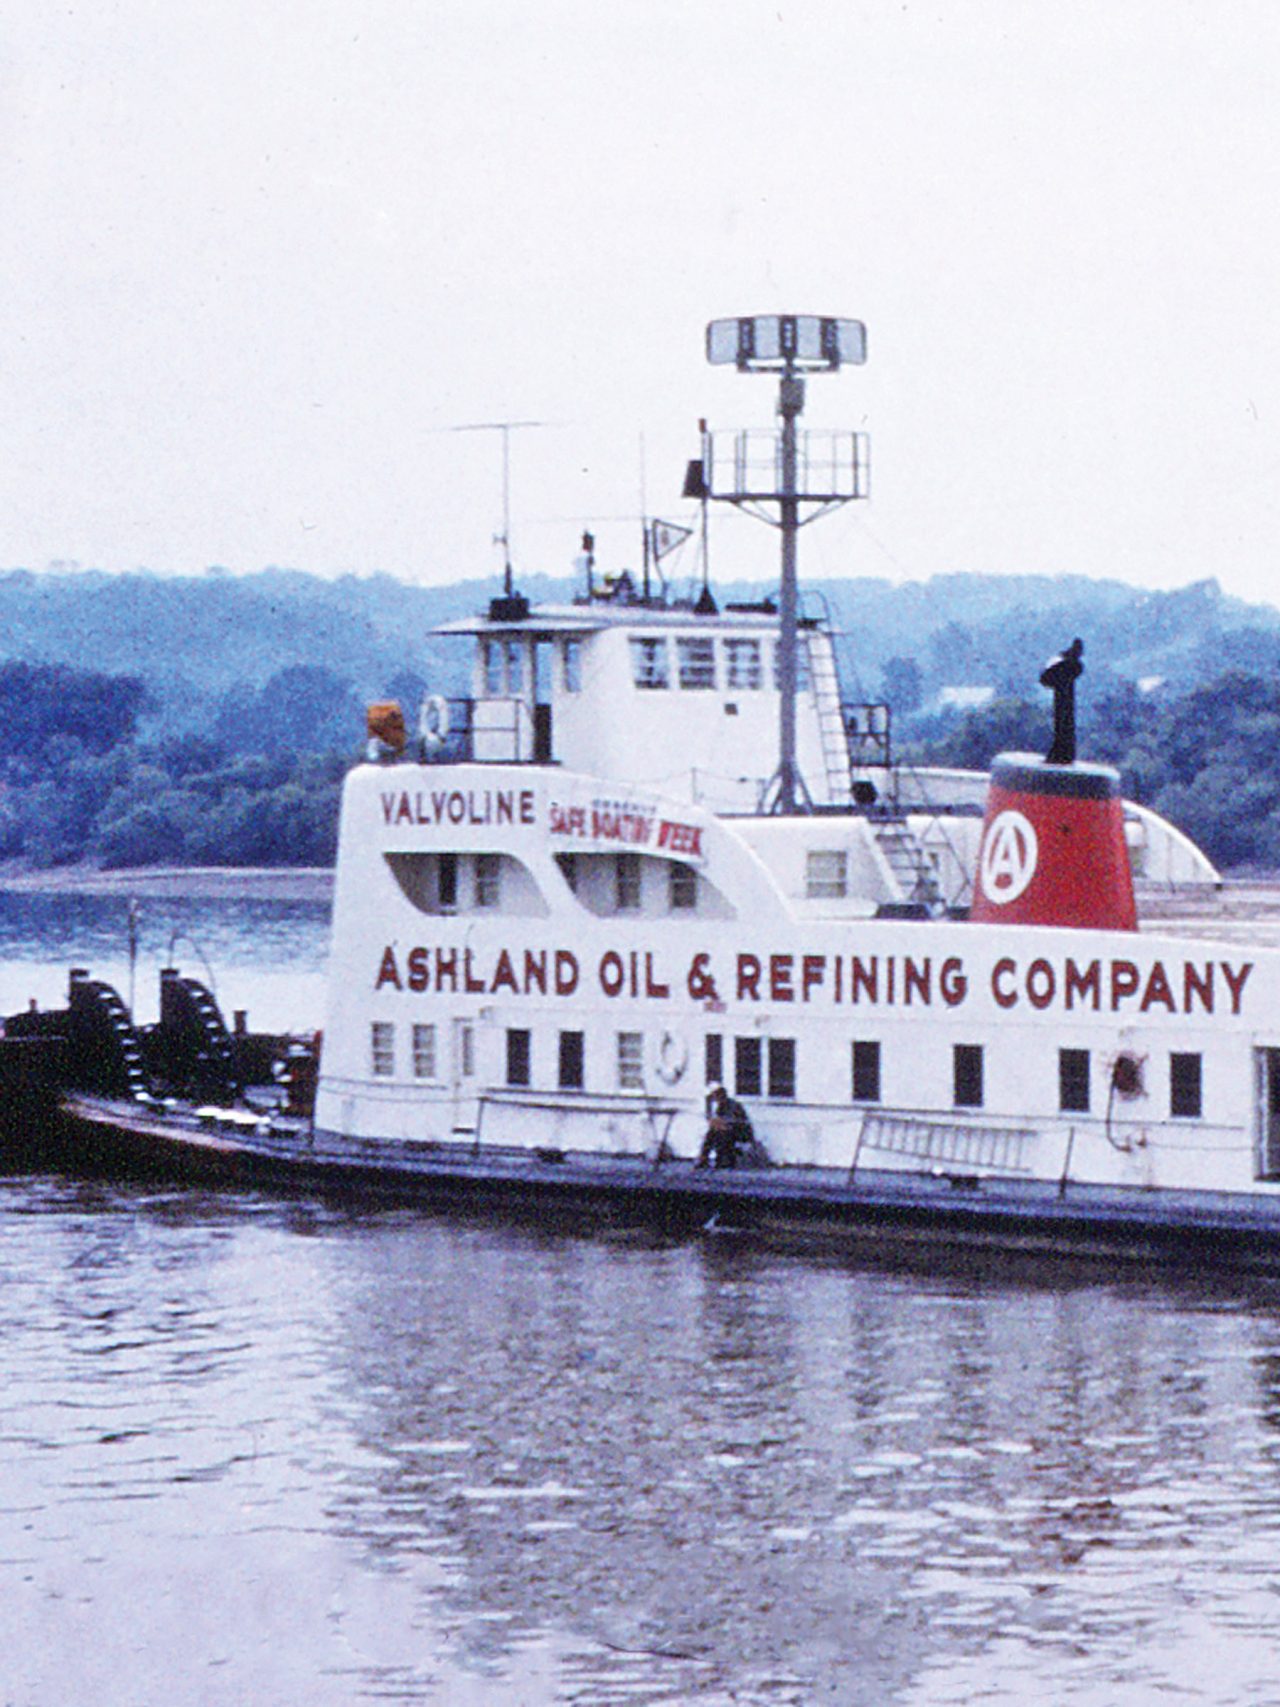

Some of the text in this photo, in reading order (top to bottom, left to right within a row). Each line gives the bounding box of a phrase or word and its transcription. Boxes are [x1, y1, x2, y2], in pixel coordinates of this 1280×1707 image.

[380, 790, 535, 825] VALVOLINE
[375, 946, 1254, 1014] ASHLAND OIL & REFINING COMPANY
